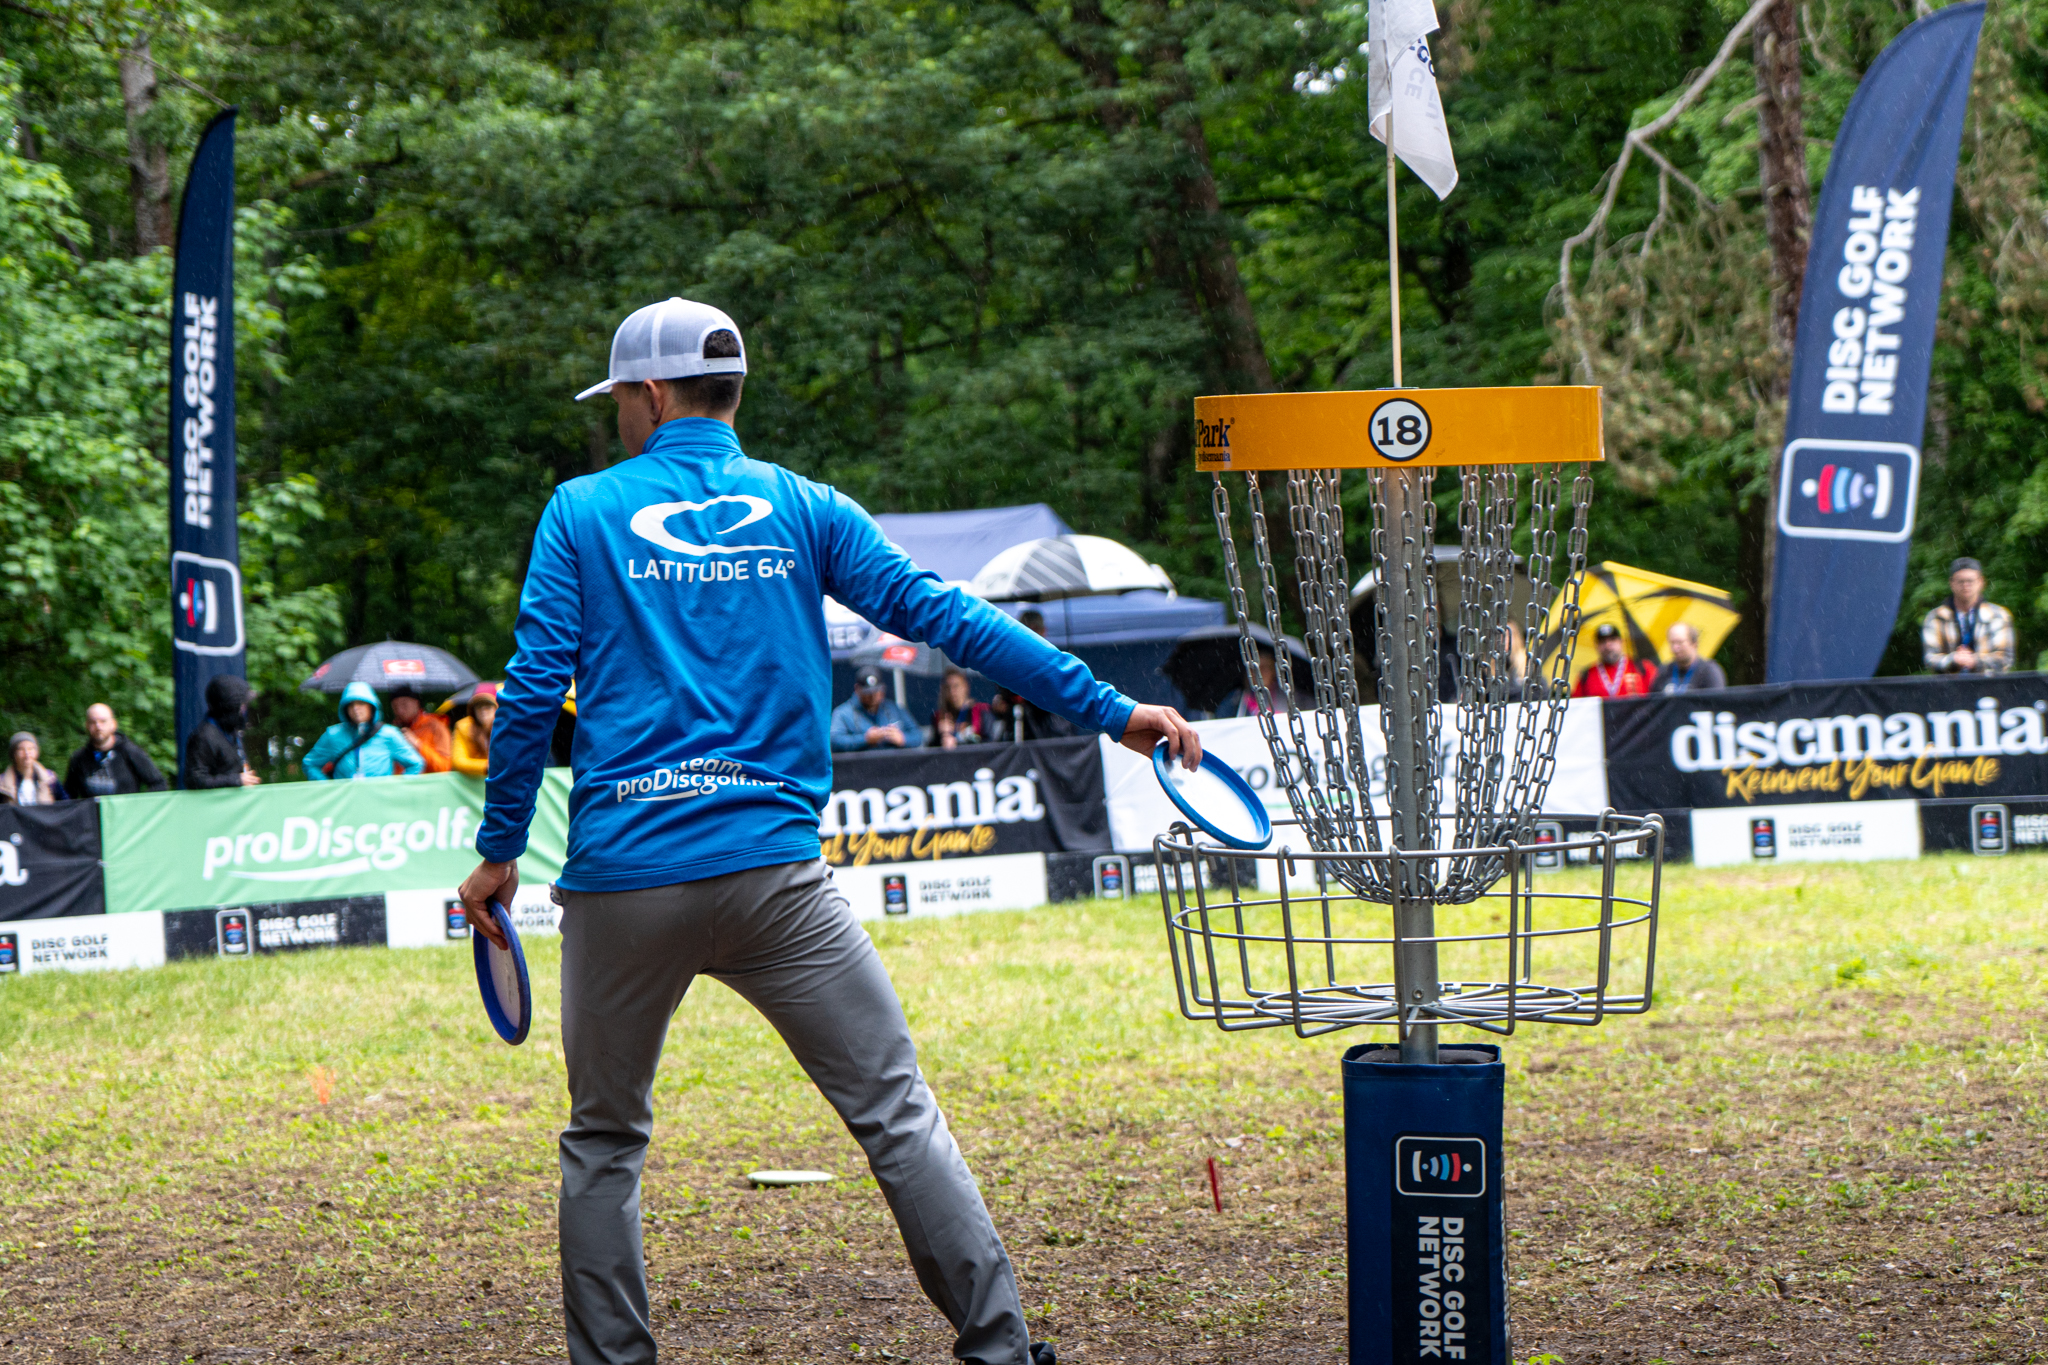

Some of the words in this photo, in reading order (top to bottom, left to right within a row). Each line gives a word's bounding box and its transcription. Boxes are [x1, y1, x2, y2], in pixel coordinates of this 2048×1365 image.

[1837, 185, 1884, 298] GOLF
[1858, 186, 1922, 415] NETWORK
[184, 292, 201, 407] GOLF
[1822, 306, 1867, 413] DISC
[197, 296, 218, 529] NETWORK
[1377, 415, 1422, 446] 18
[184, 417, 200, 527] DISC
[628, 558, 750, 583] LATITUDE
[757, 557, 796, 579] 64°
[818, 767, 1046, 836] mania
[1722, 752, 1843, 804] Reinvent
[1844, 754, 1909, 800] Your
[1910, 742, 2001, 797] Game
[202, 806, 484, 880] proDiscgolf.
[847, 825, 911, 867] Your
[911, 814, 998, 862] Game
[32, 938, 66, 950] DISC
[71, 933, 109, 947] GOLF
[32, 948, 109, 963] NETWORK
[258, 916, 296, 931] DISC
[297, 912, 337, 928] GOLF
[259, 926, 339, 948] NETWORK
[1442, 1216, 1465, 1283] DISC
[1418, 1216, 1441, 1358] NETWORK
[1443, 1290, 1466, 1360] GOLF
